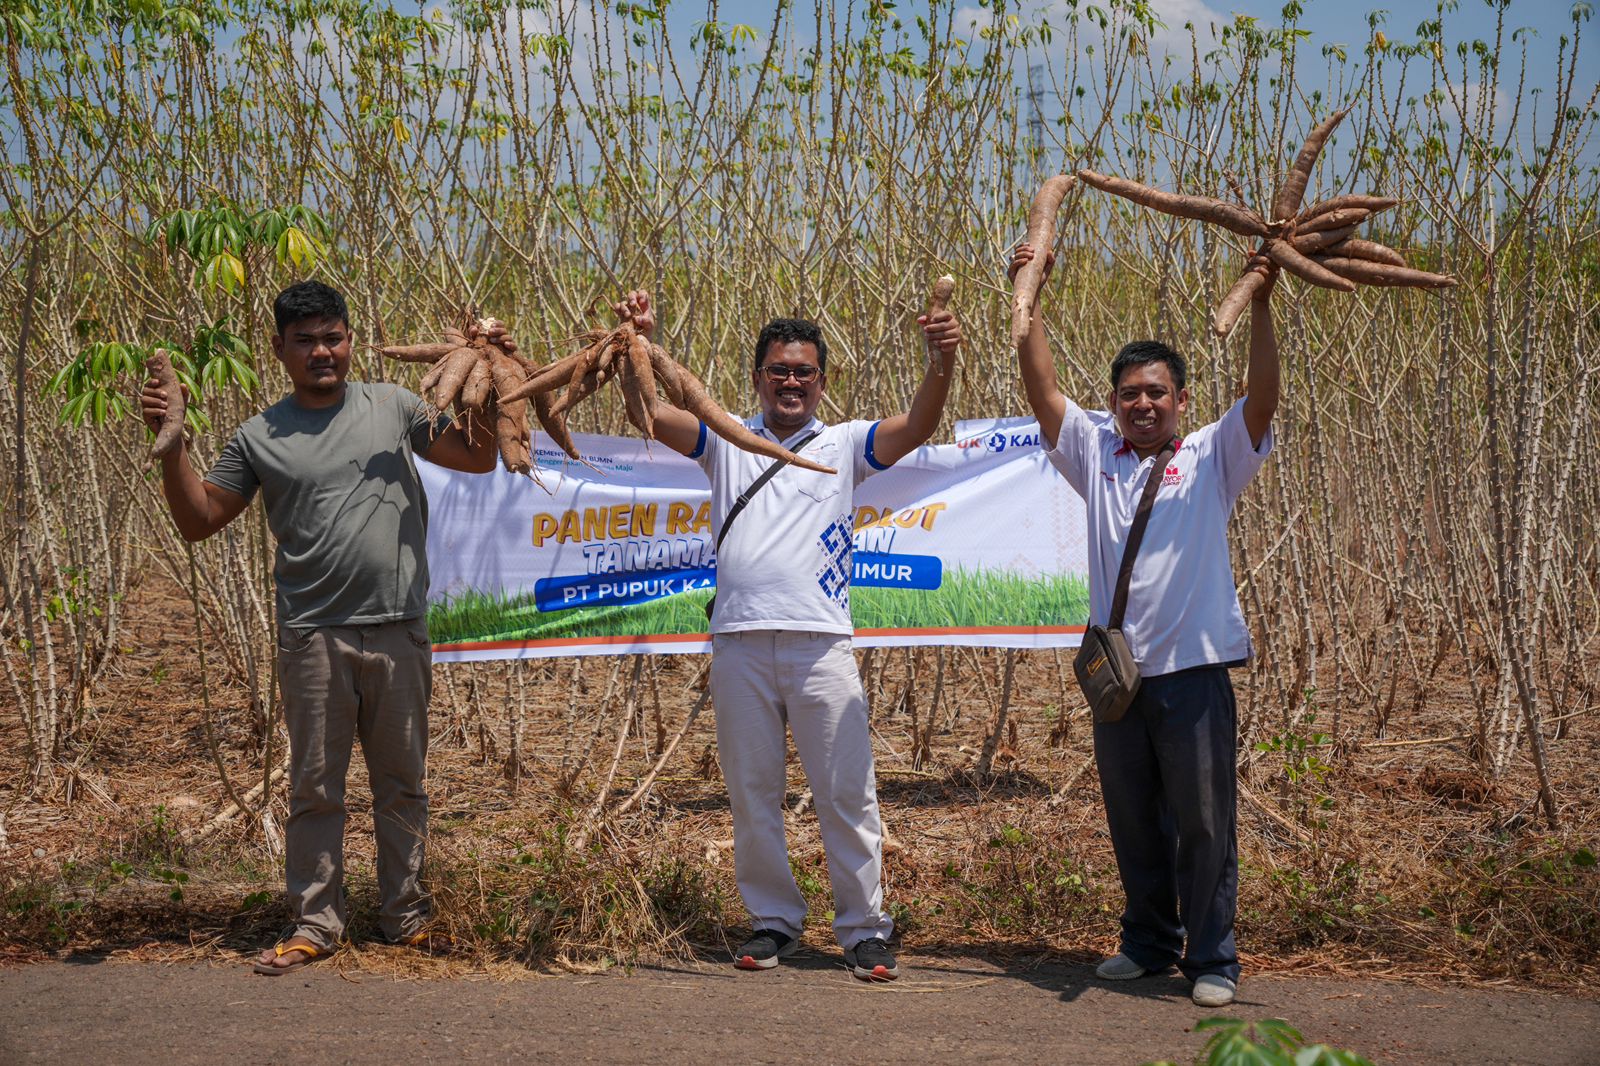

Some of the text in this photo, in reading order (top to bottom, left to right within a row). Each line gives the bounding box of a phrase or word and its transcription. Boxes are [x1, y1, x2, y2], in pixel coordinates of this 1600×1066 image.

[535, 449, 613, 464] KEMENTN BUMN
[532, 503, 658, 547] PANEN
[583, 538, 717, 575] TANAMA
[563, 585, 591, 603] PT
[598, 579, 675, 599] PUPUK
[851, 562, 912, 581] IMUR
